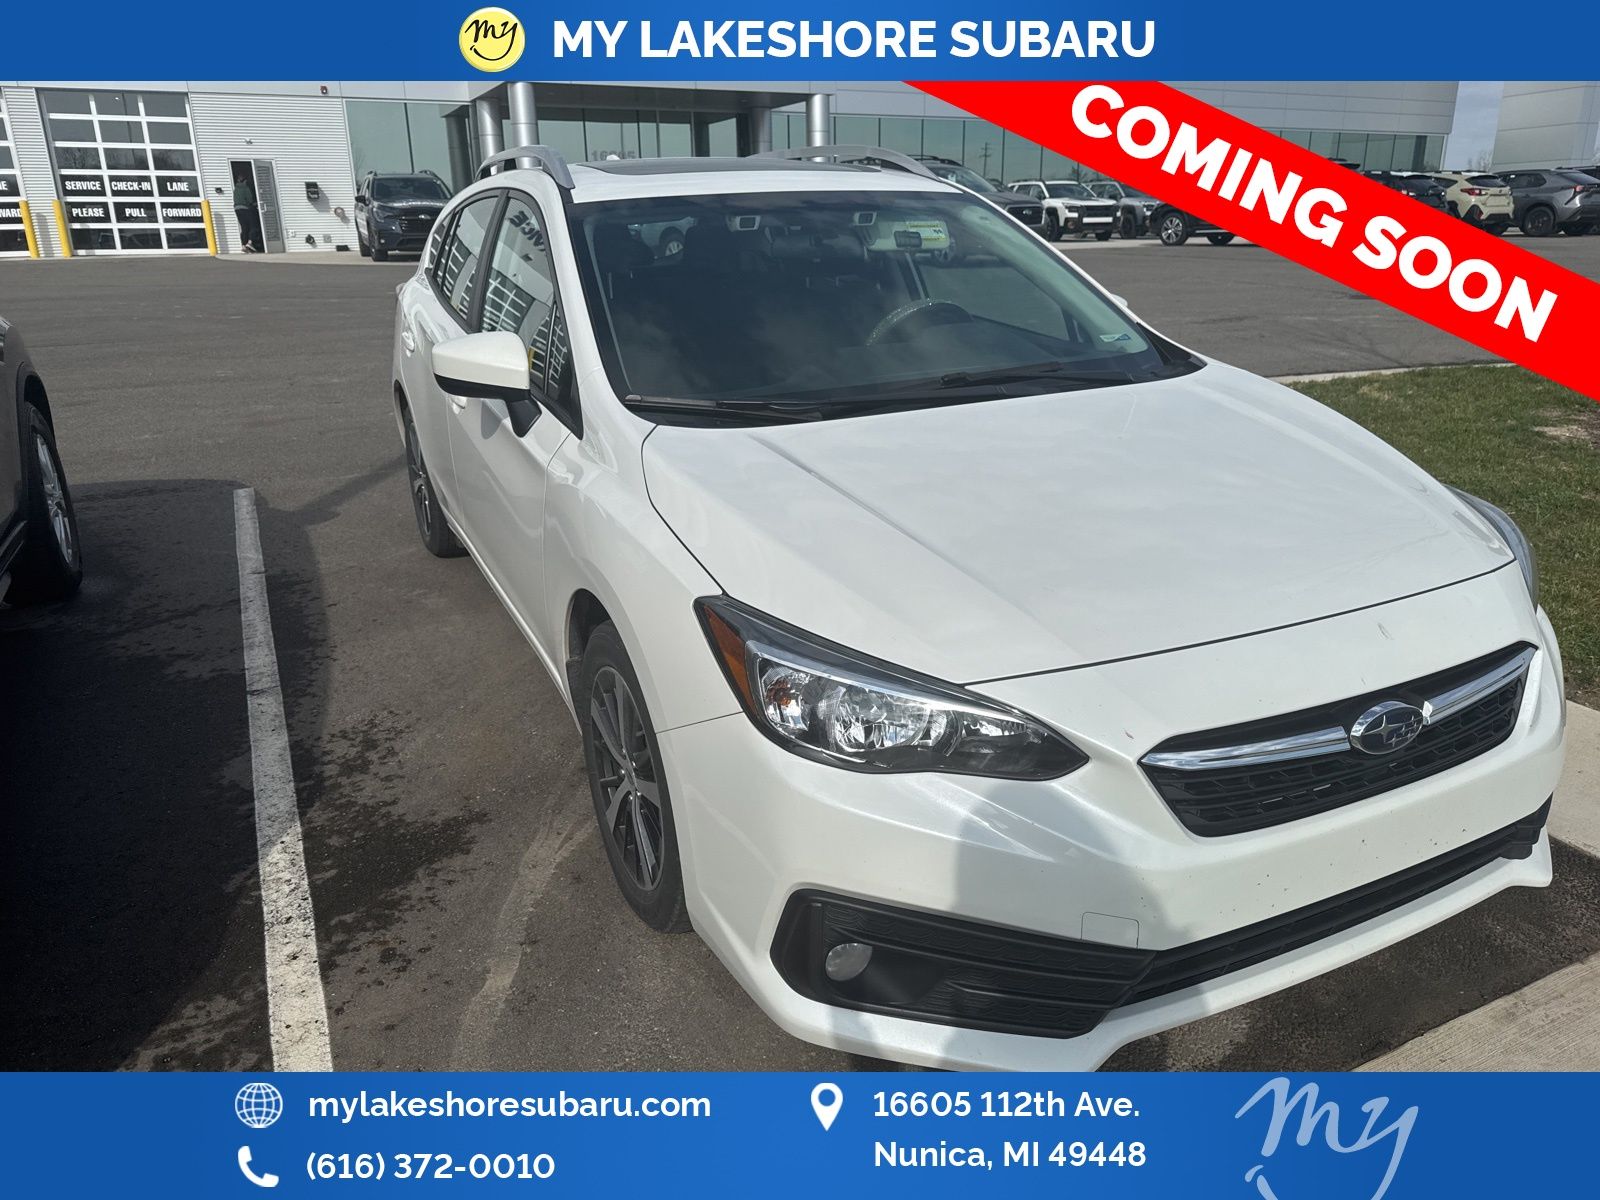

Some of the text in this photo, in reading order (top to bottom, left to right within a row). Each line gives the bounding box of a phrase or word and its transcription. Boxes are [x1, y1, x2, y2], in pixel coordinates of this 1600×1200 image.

[65, 181, 189, 191] SERVICE CHECK-IN LANE
[72, 208, 202, 217] PLEASE PULL FORWARD
